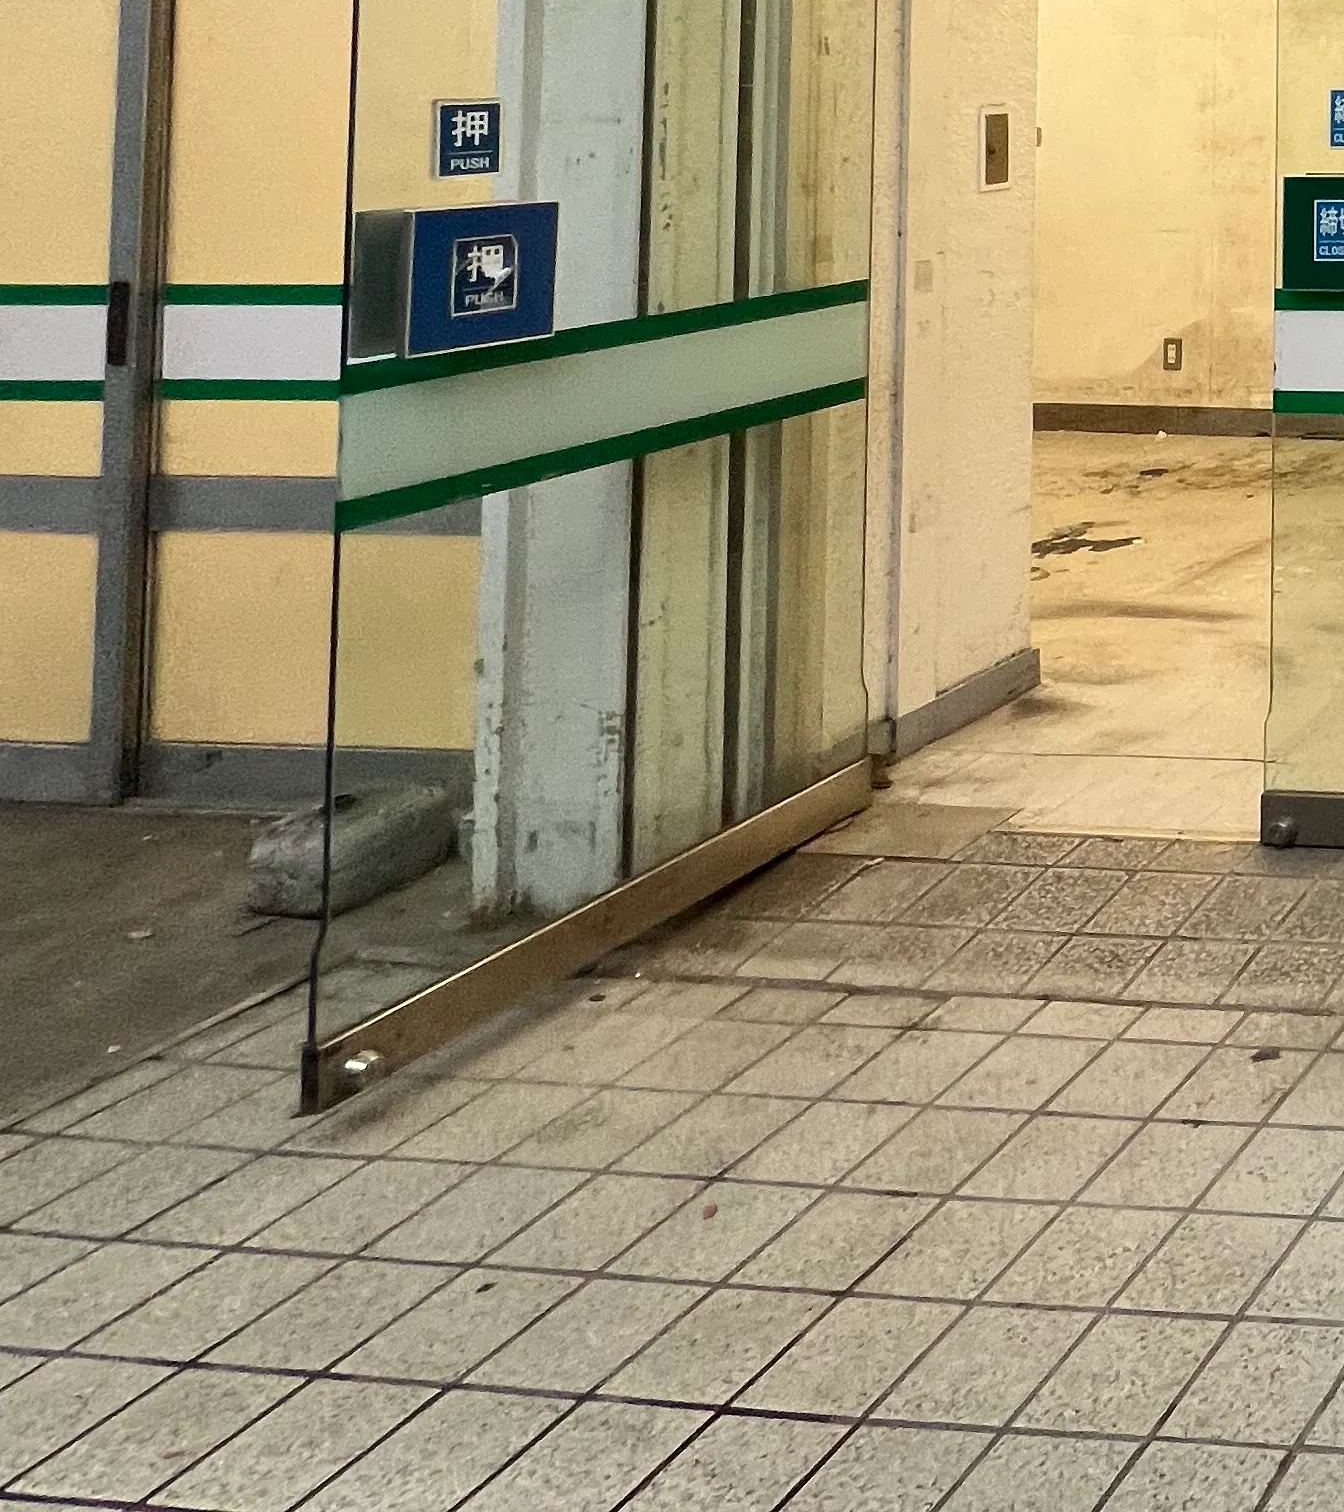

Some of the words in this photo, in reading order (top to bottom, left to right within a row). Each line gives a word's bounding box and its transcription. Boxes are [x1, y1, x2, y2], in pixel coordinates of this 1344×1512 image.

[451, 109, 489, 147] 押
[450, 155, 490, 172] PUSH
[466, 243, 505, 284] 押
